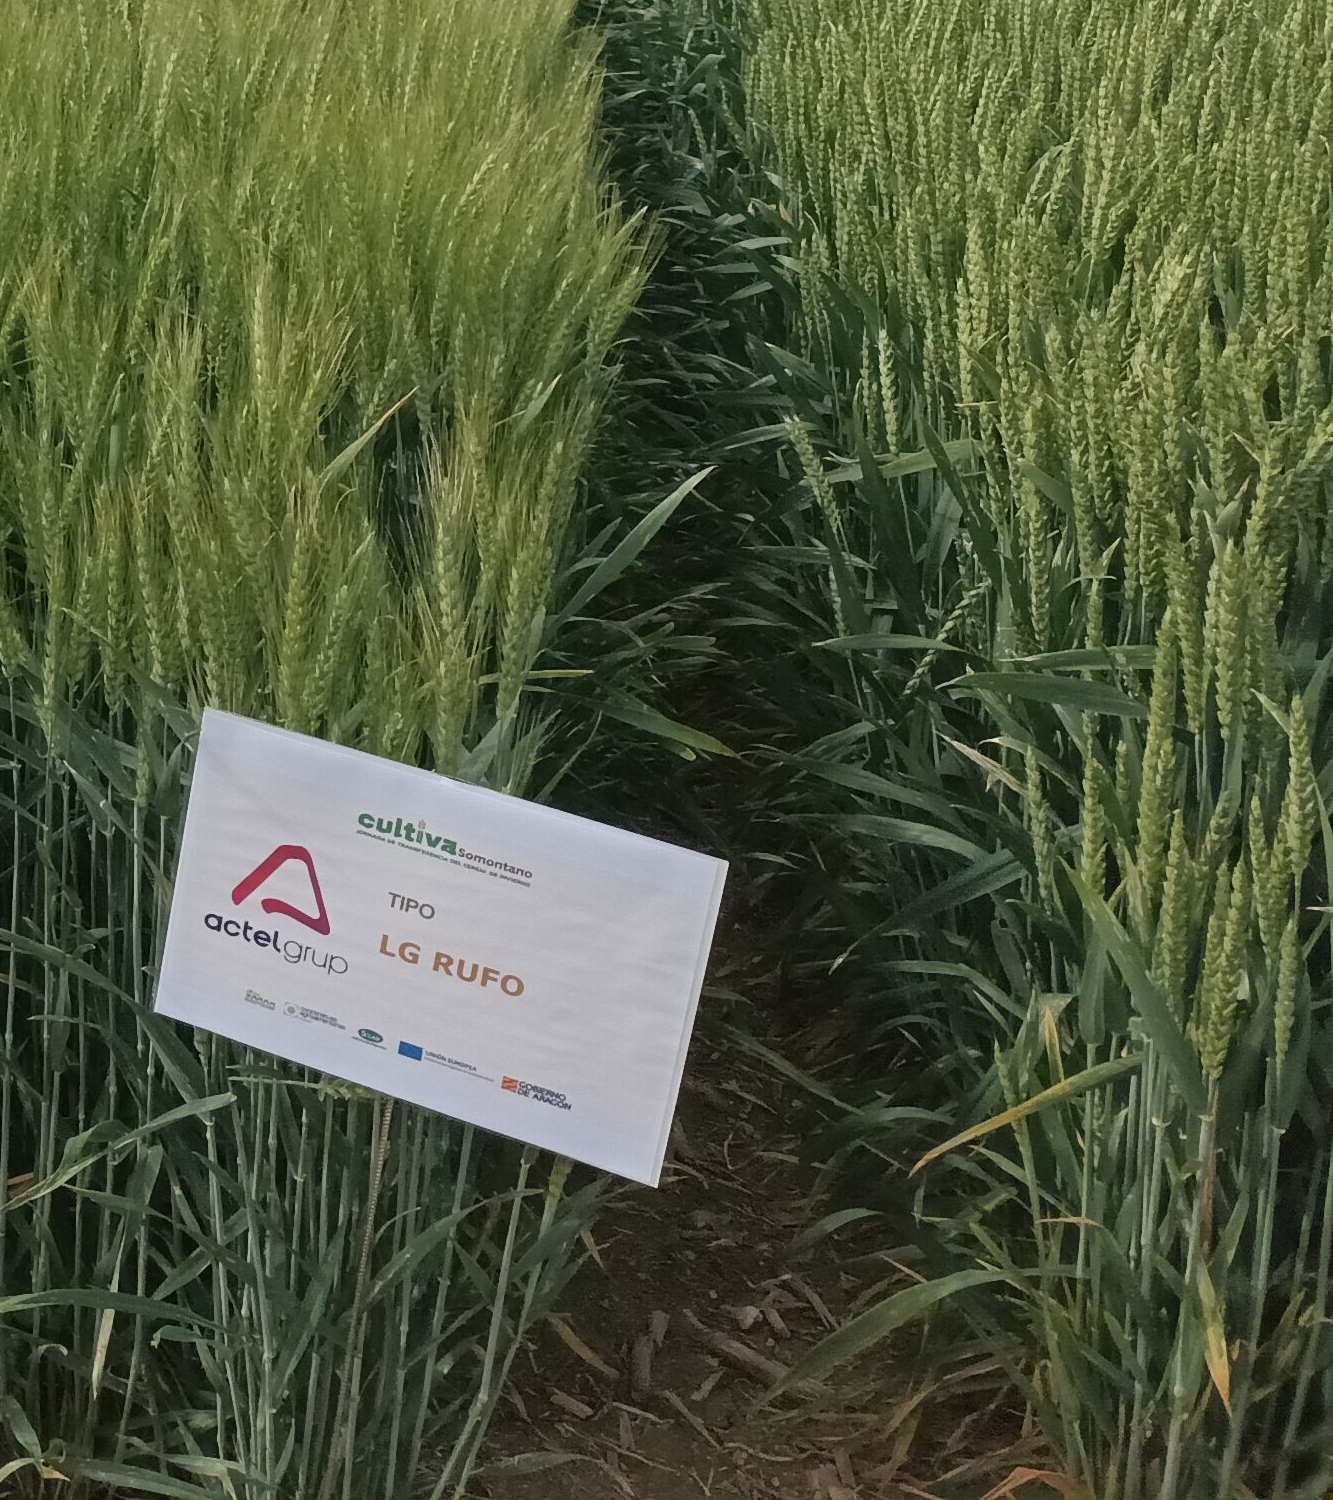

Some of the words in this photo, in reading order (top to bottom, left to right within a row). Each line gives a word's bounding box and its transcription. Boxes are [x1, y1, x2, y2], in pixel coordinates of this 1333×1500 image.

[388, 891, 436, 920] TIPO
[204, 912, 349, 975] actelgrup
[379, 933, 421, 964] LG
[432, 949, 525, 997] RUFO
[517, 1088, 530, 1098] DE
[519, 1081, 567, 1102] GOBIERNO
